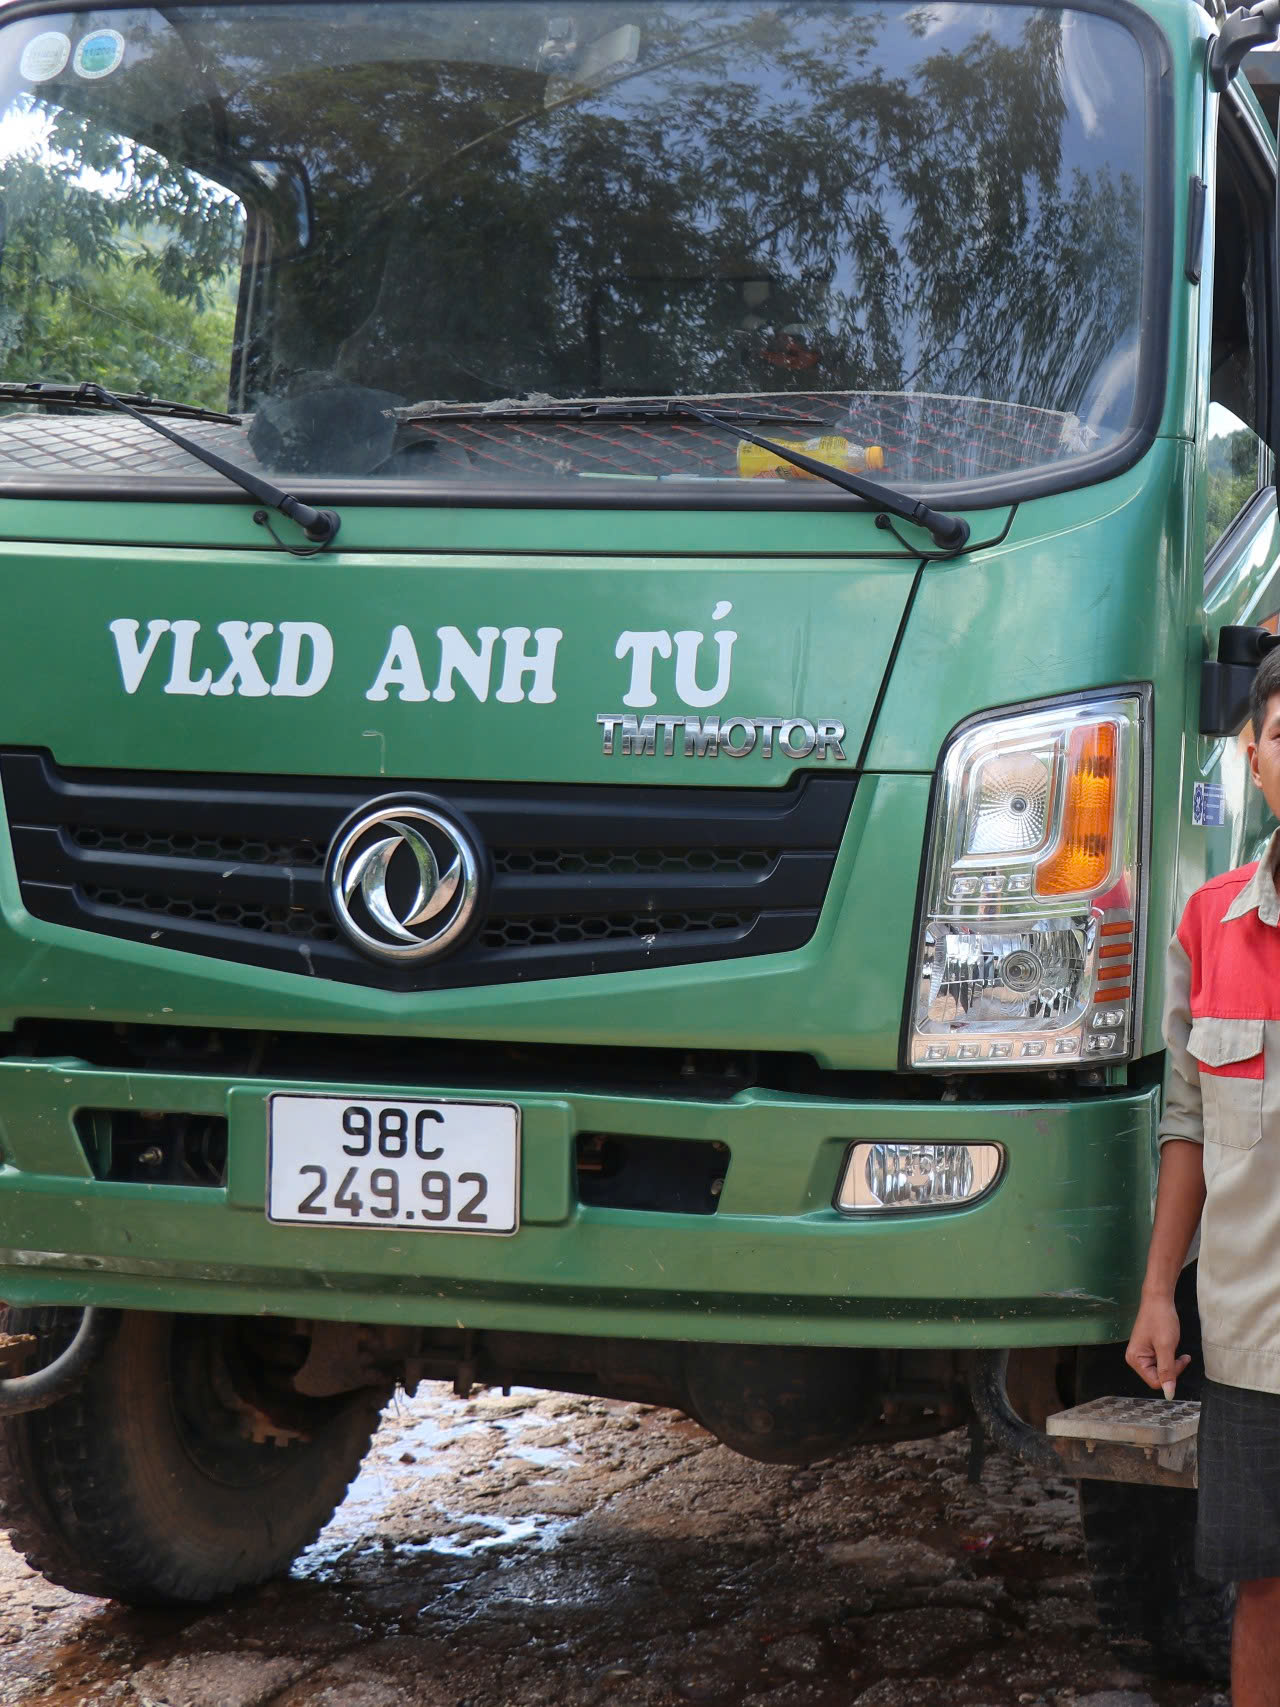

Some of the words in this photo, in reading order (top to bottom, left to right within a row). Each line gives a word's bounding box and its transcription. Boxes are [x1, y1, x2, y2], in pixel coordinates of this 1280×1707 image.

[109, 618, 334, 698] VLXD
[365, 624, 563, 704] ANH
[614, 600, 738, 708] TÚ
[342, 1106, 445, 1160] 98C
[297, 1164, 489, 1224] 249.92
